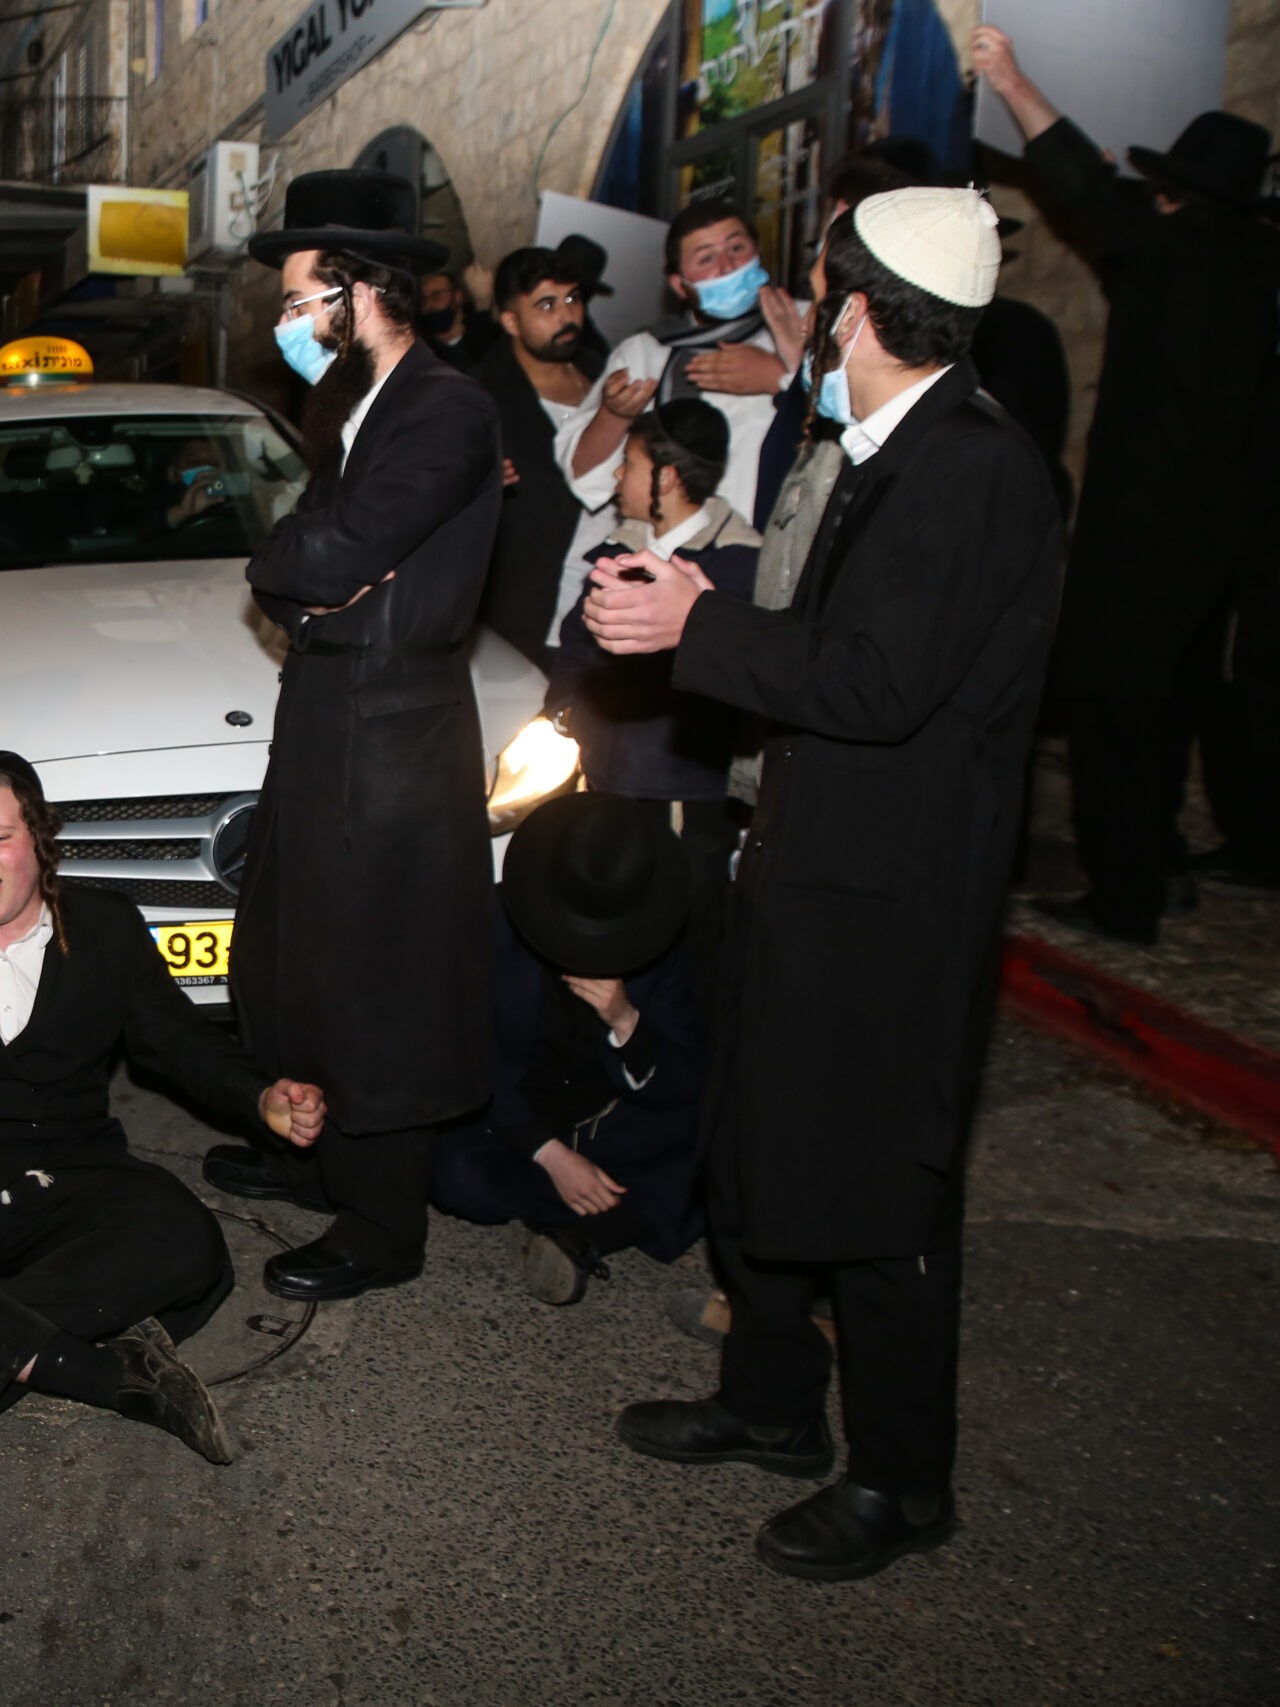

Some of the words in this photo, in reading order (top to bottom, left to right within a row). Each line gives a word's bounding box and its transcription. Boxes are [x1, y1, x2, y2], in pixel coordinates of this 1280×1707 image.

[273, 4, 332, 94] YIGAL
[44, 355, 82, 368] מונית
[167, 931, 229, 969] 93
